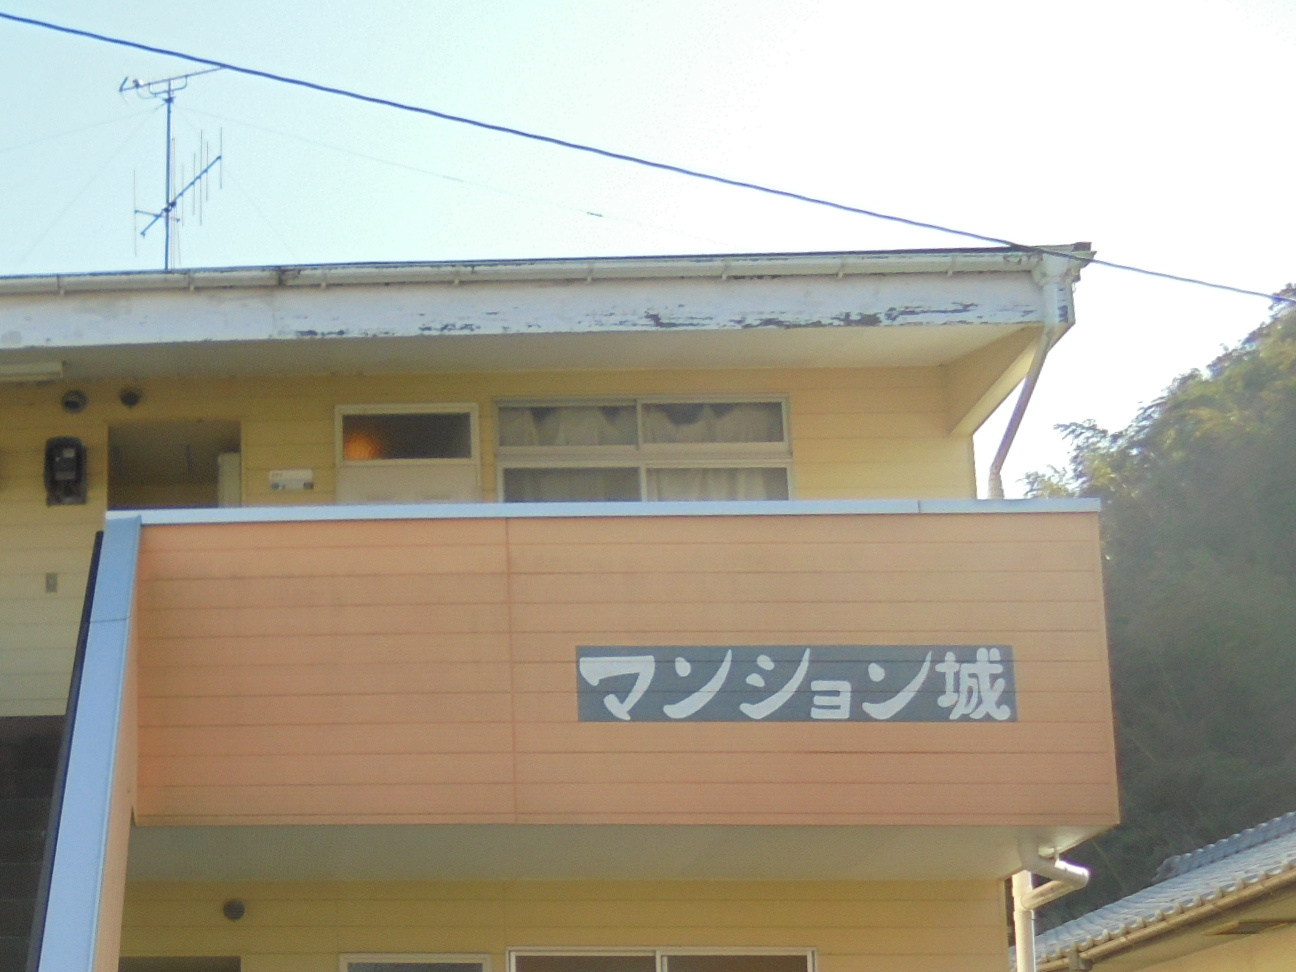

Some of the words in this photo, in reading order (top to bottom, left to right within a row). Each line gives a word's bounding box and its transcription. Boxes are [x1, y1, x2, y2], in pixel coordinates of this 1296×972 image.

[579, 647, 1011, 720] マンション城
